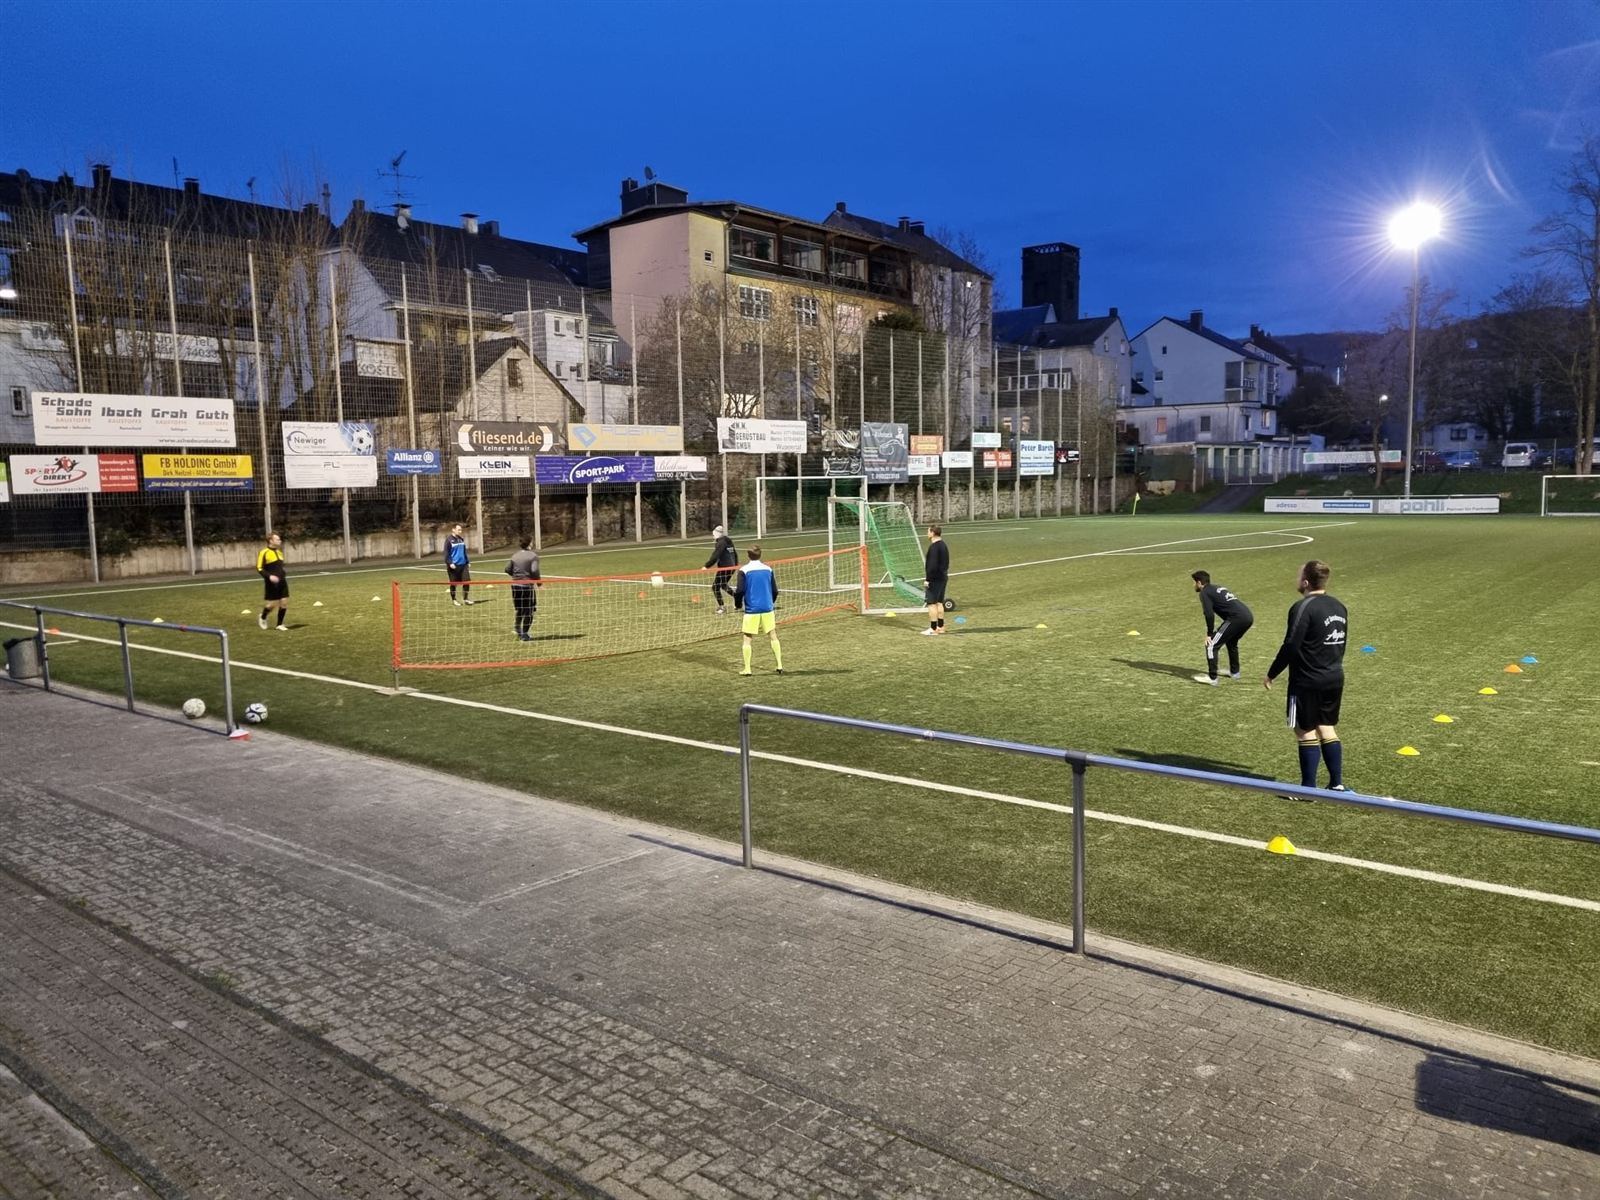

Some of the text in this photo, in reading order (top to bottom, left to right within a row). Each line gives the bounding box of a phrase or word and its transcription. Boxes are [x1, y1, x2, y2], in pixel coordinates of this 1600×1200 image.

[41, 397, 92, 407] Schade
[56, 407, 92, 417] Sohn
[101, 407, 142, 417] Ibach
[151, 408, 188, 419] Grah
[196, 410, 229, 420] Guth
[294, 436, 327, 446] Newiger
[472, 430, 542, 445] fliesend.de
[1020, 444, 1037, 452] Peter
[393, 452, 423, 462] Allianz
[160, 458, 237, 468] FB HOLDING GmbH
[575, 464, 625, 478] SPORT-PARK
[592, 475, 610, 483] GROUP
[1276, 501, 1298, 509] adesso
